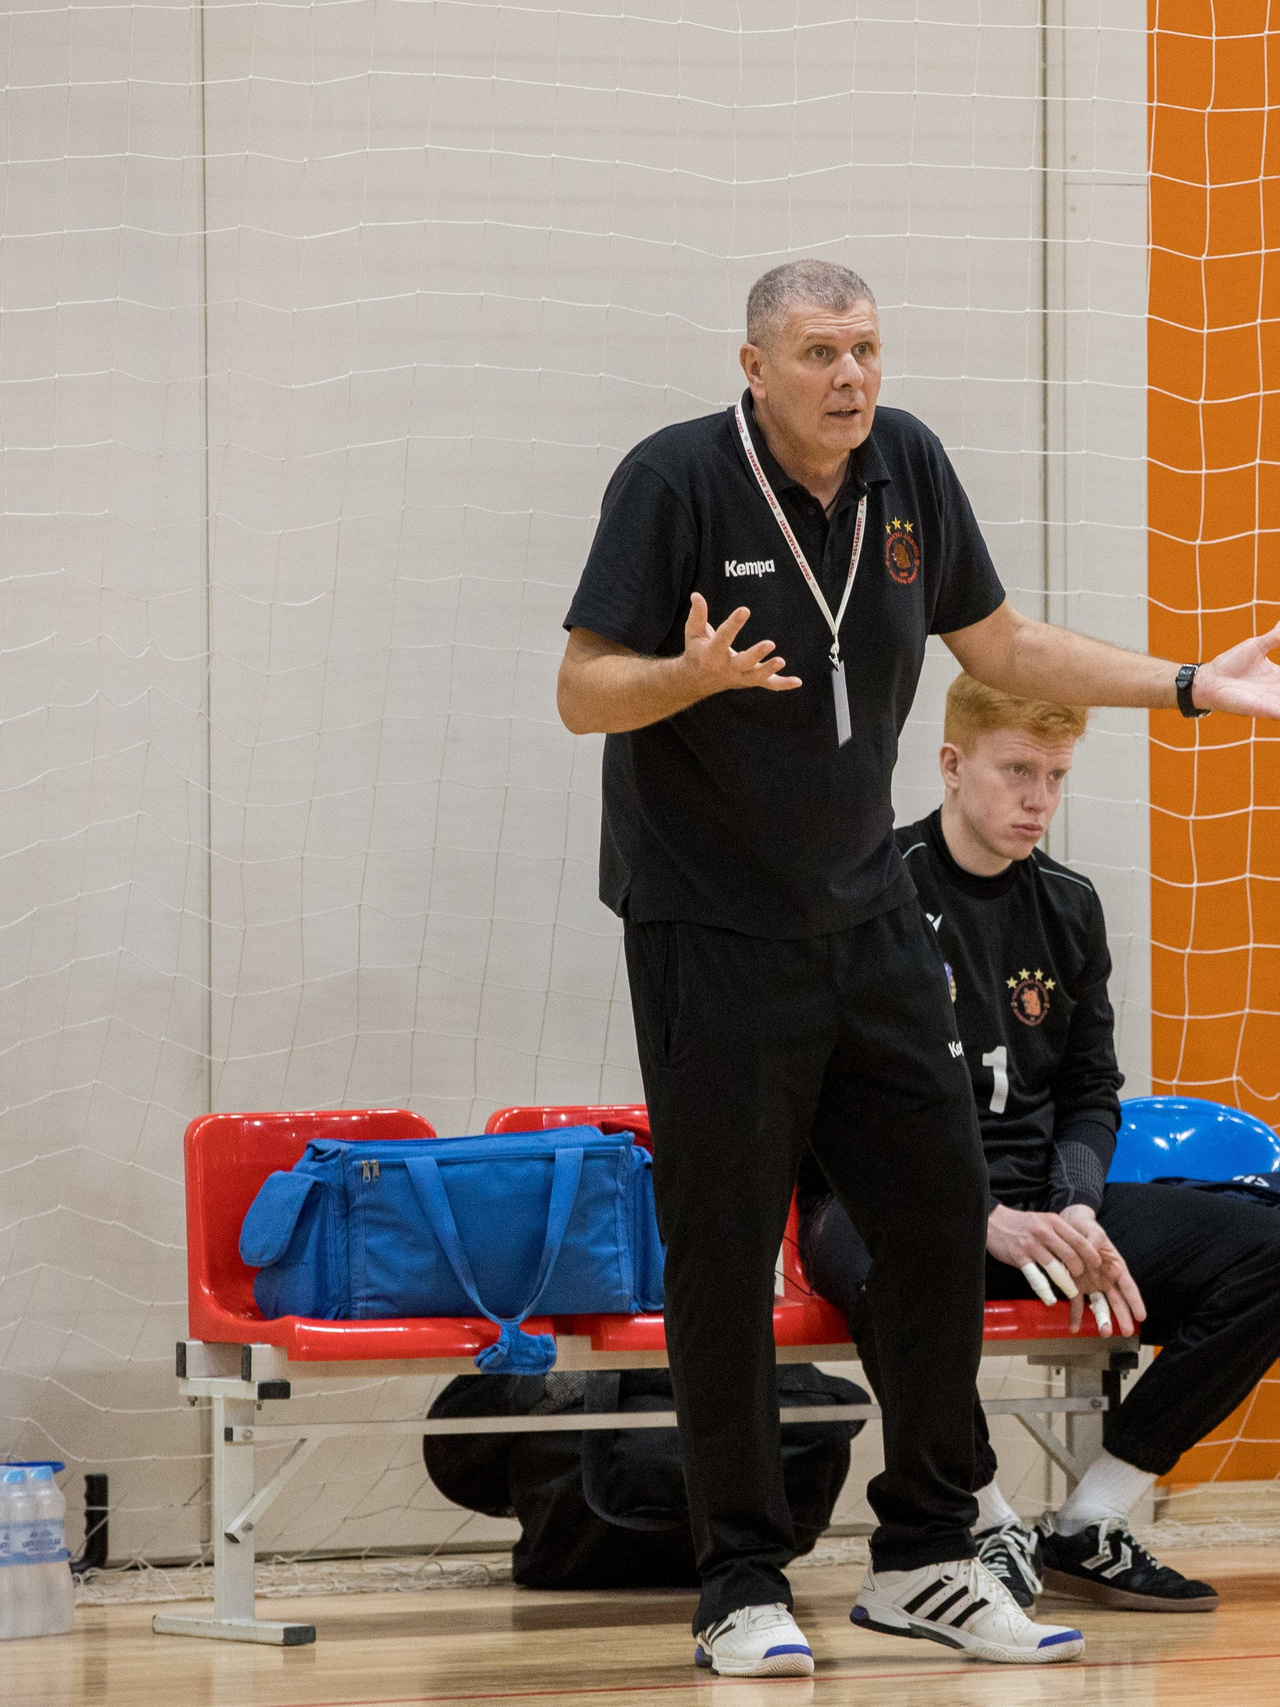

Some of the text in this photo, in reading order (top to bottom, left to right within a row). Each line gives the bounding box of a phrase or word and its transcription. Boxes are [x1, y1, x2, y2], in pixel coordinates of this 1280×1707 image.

[747, 449, 777, 509] СПОРТ ОБЪЕДИНЯЕТ
[725, 559, 775, 578] Kempa
[780, 520, 811, 580] СПОРТ ОБЪЕДИНЯЕТ
[982, 1046, 1009, 1114] 1
